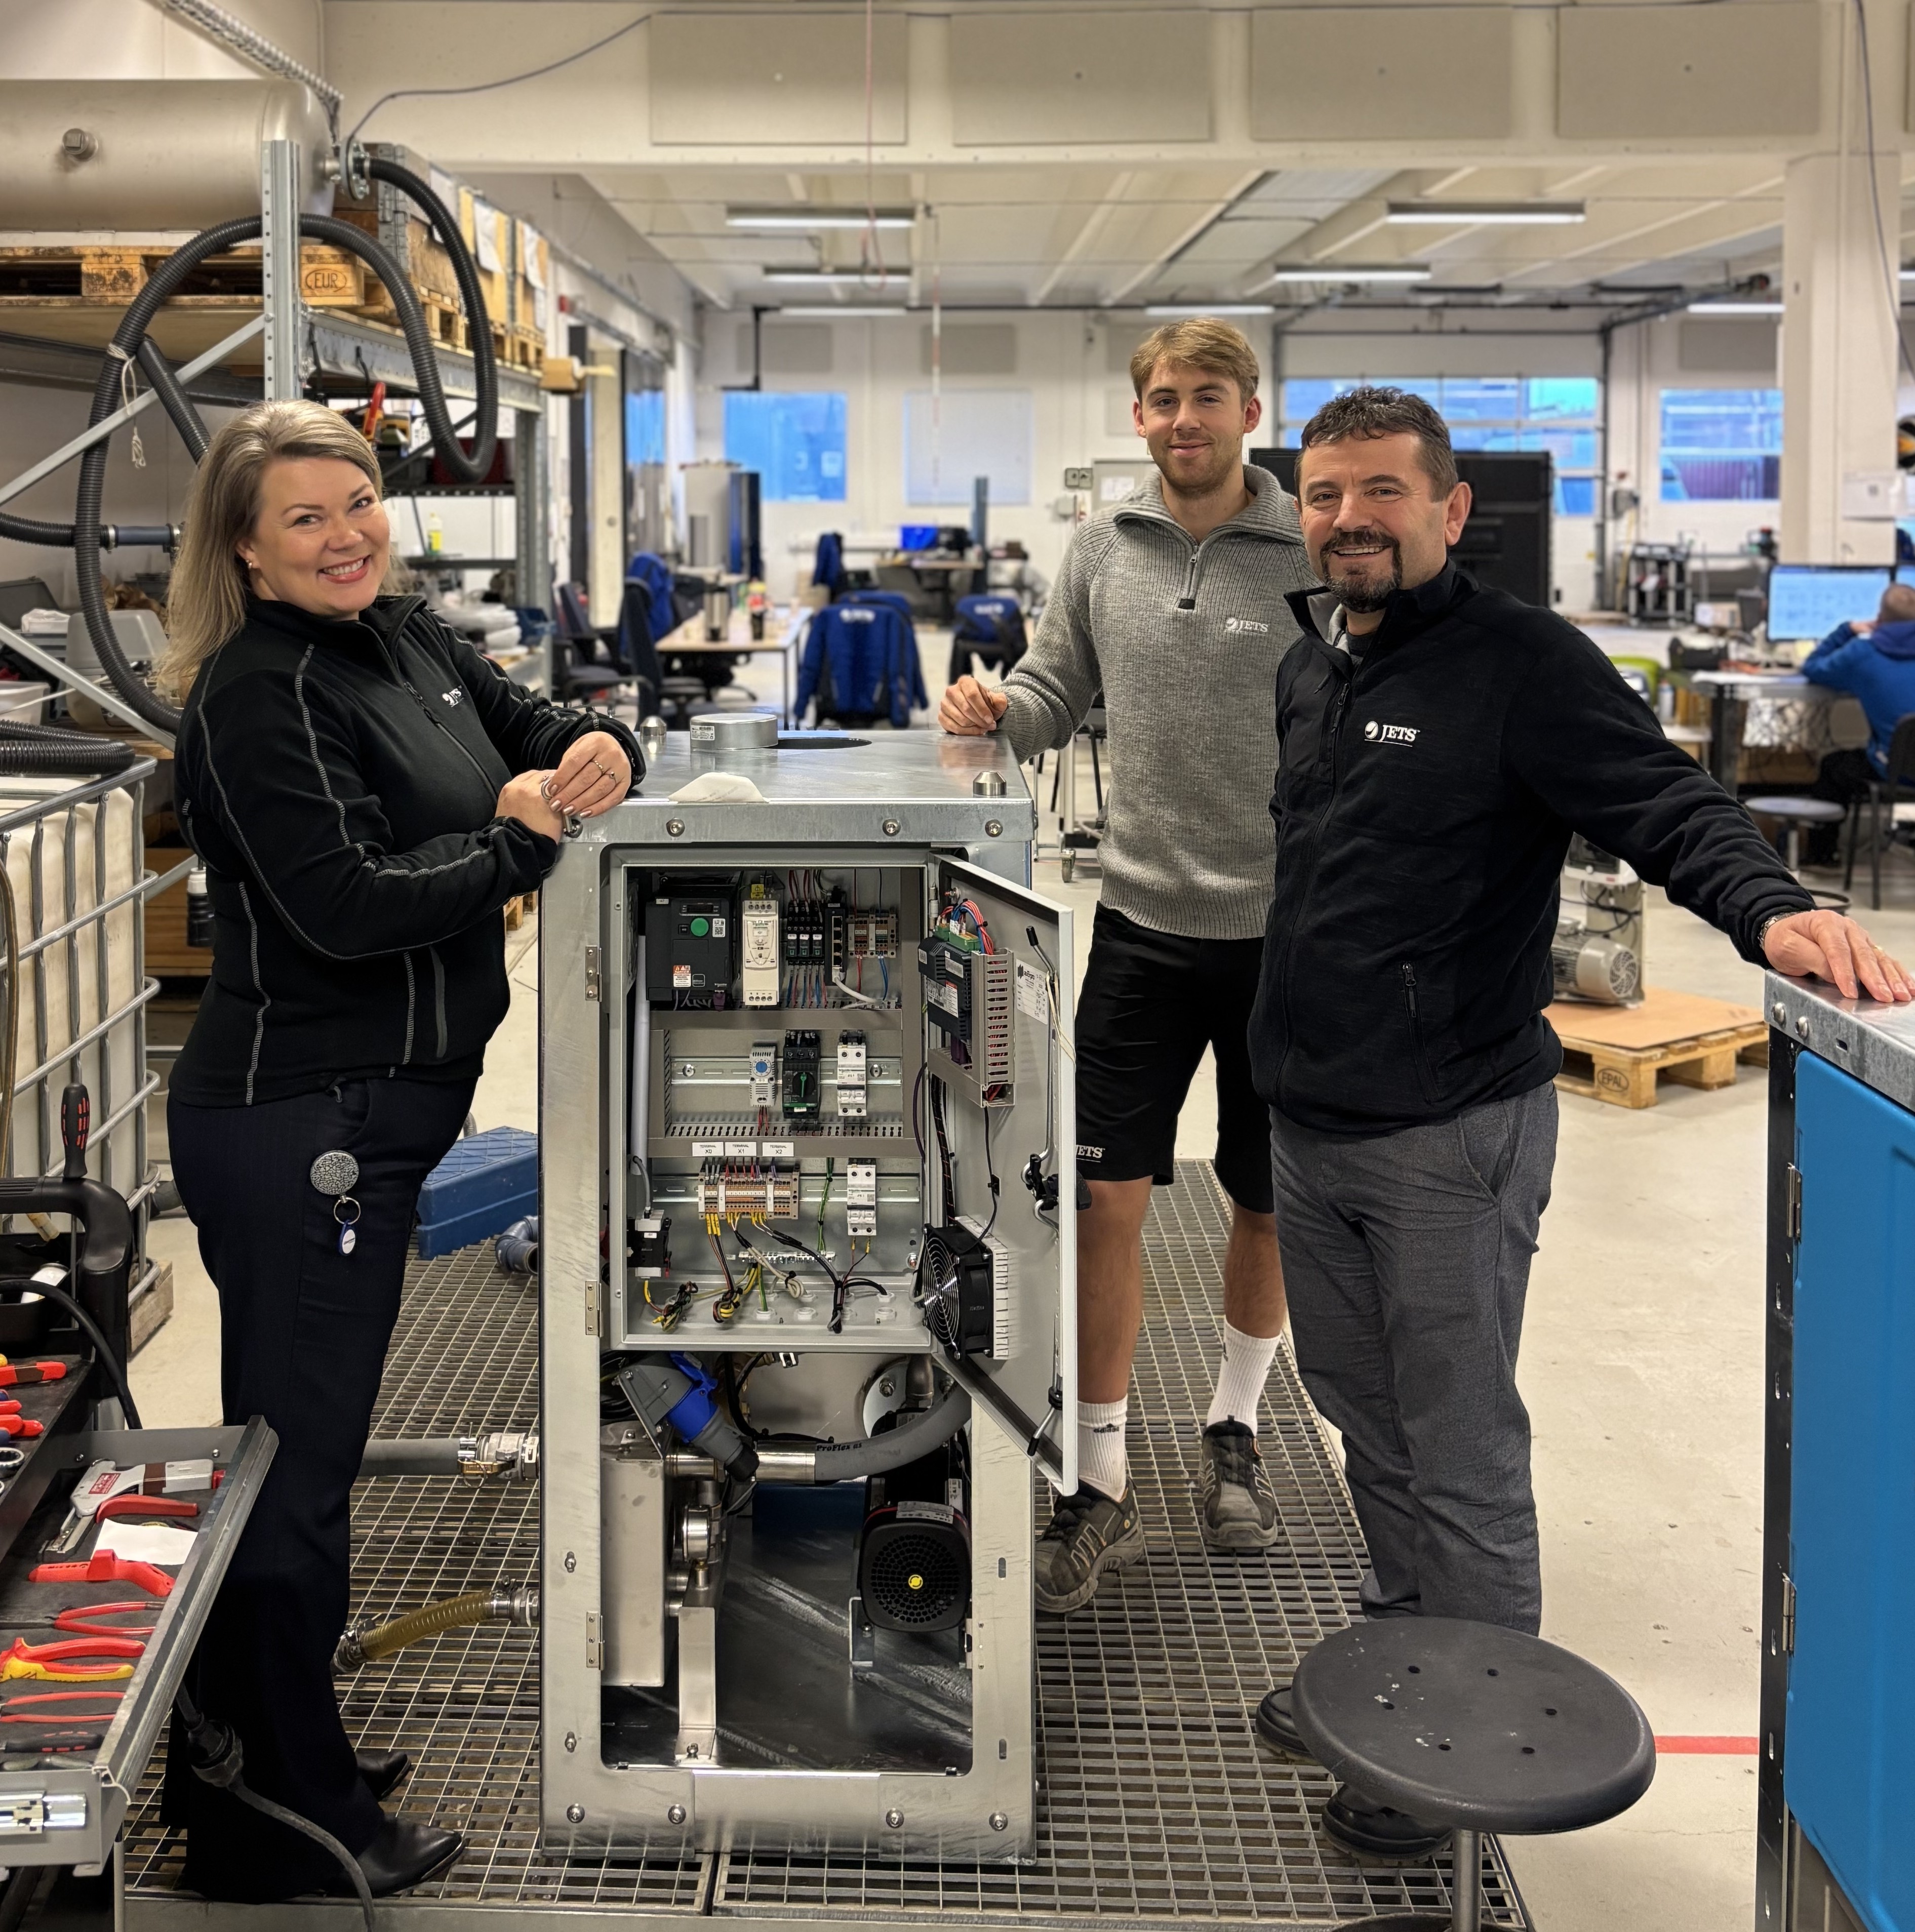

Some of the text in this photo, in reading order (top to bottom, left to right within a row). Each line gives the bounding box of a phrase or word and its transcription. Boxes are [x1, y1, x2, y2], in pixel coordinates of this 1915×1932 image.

[314, 272, 338, 289] EUR
[1235, 620, 1268, 632] JETS
[1378, 724, 1417, 743] JETS
[1602, 1071, 1627, 1090] EPAL
